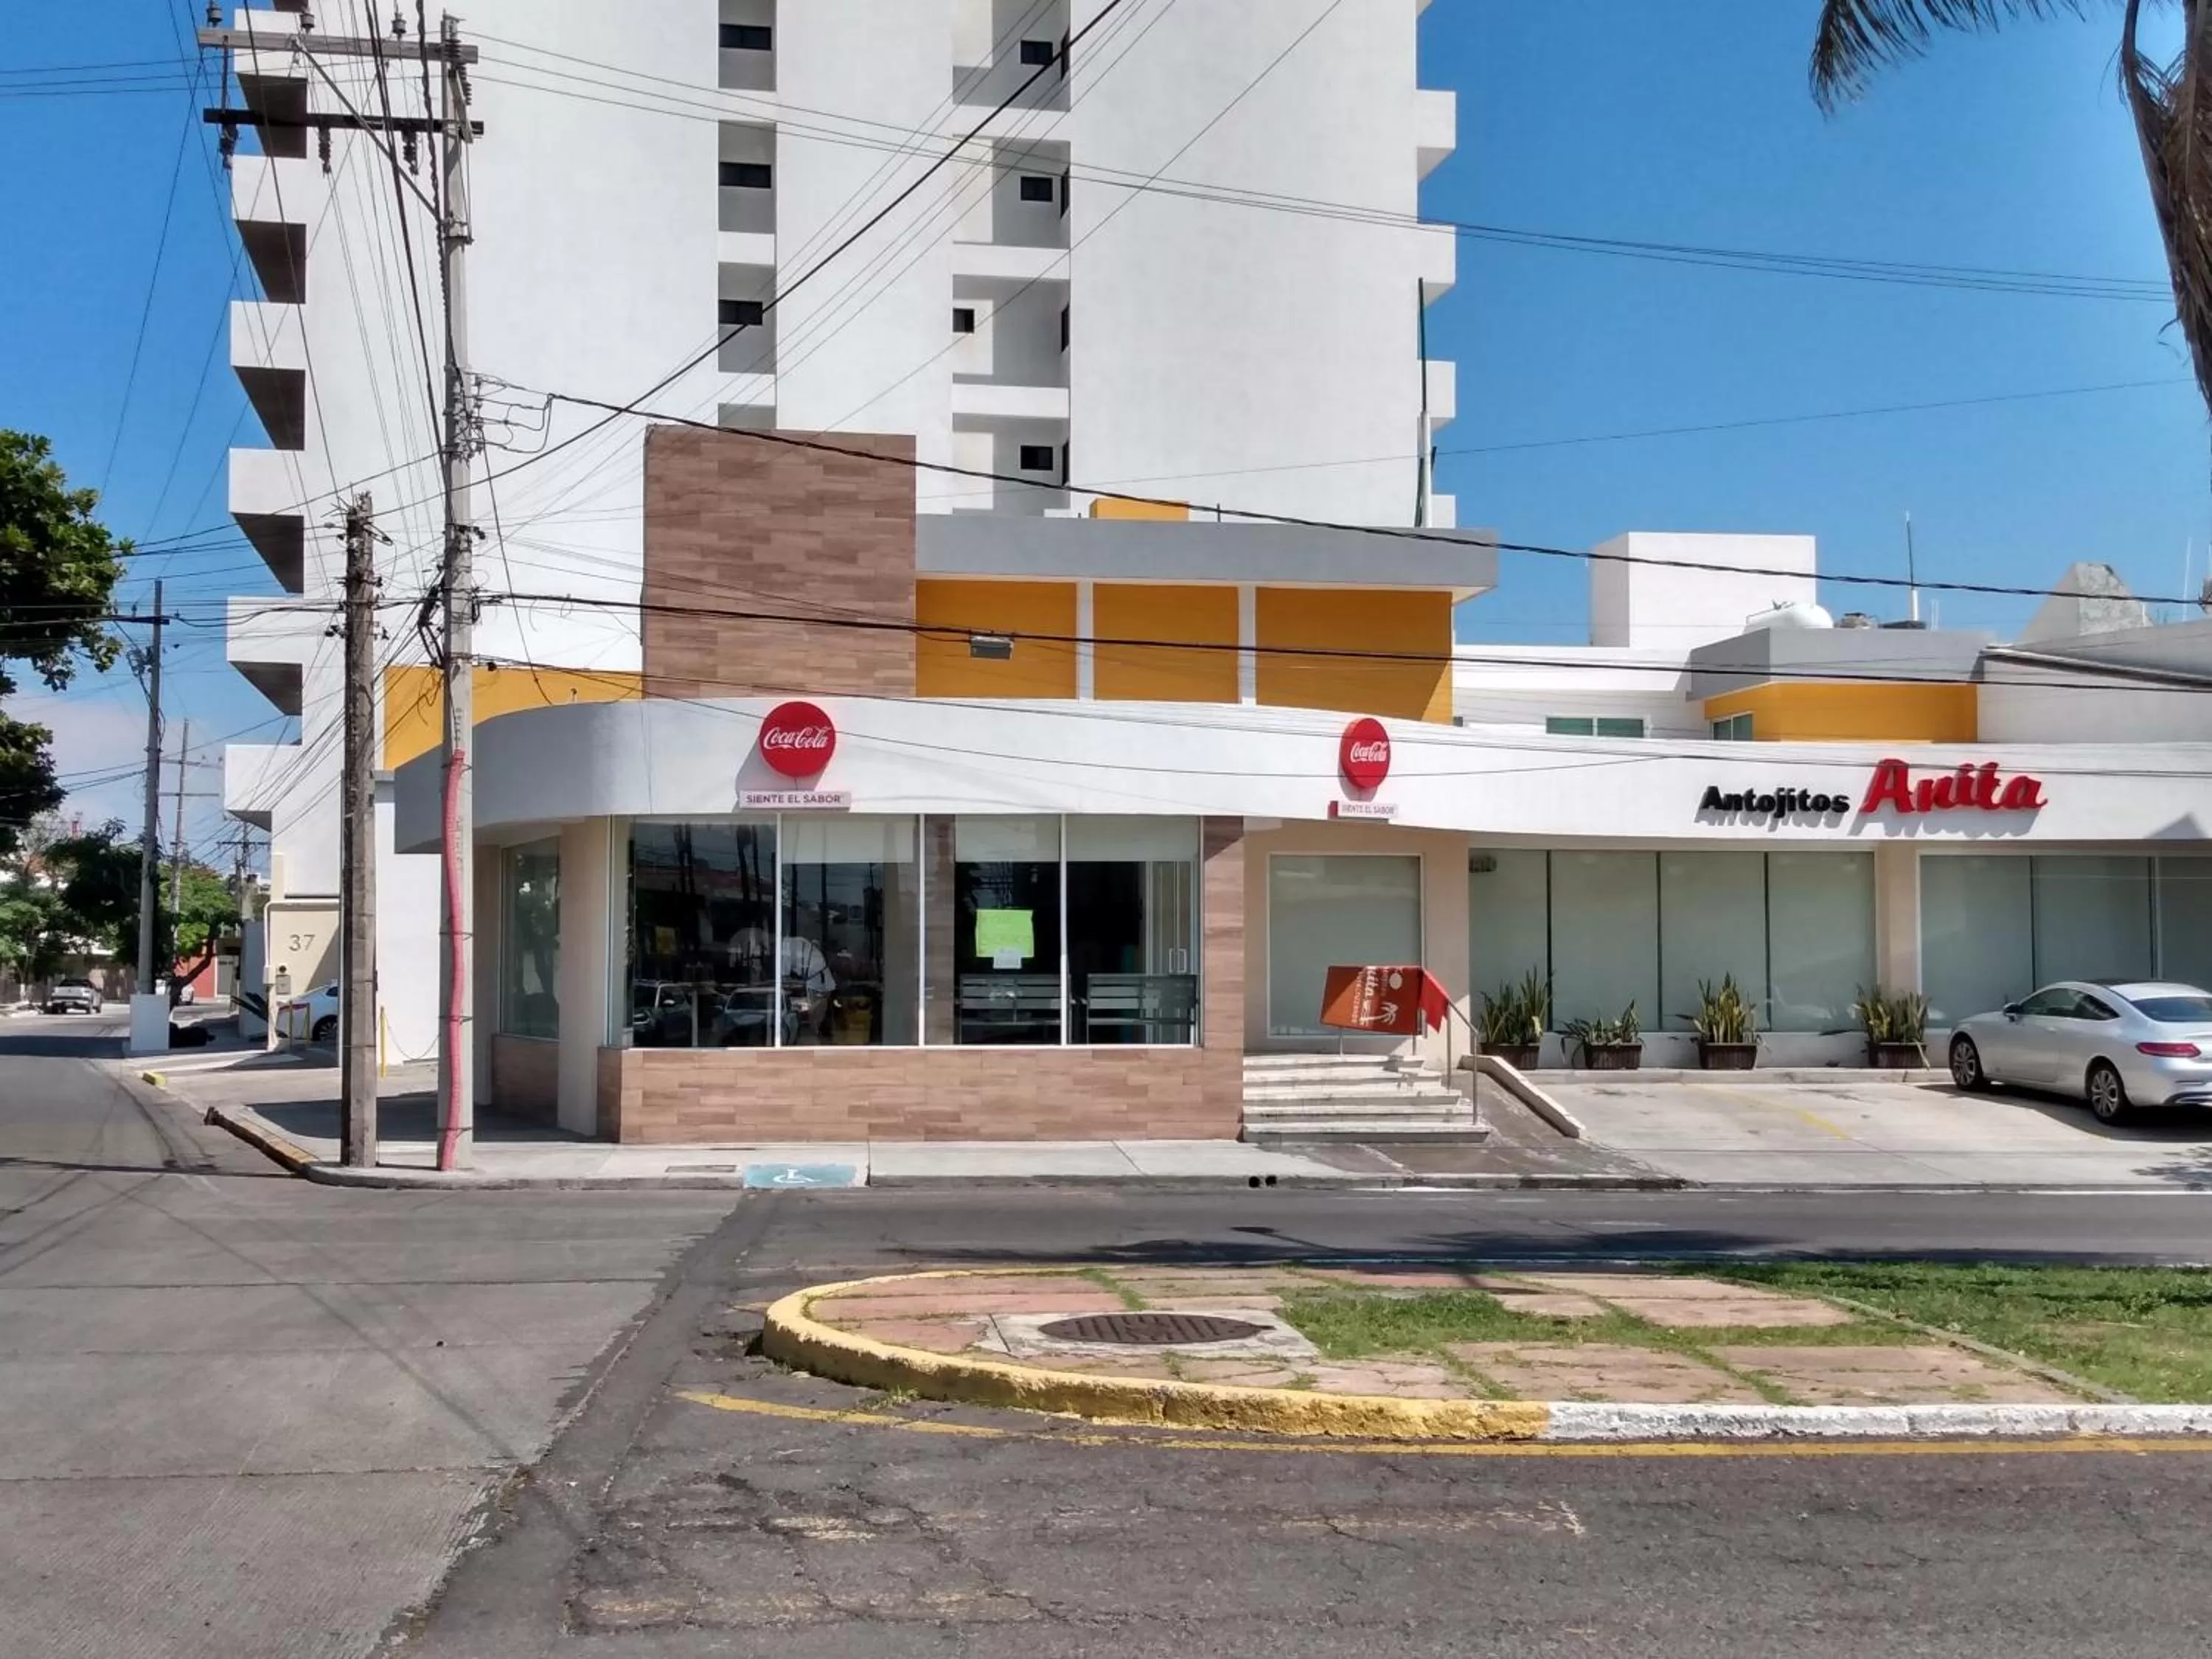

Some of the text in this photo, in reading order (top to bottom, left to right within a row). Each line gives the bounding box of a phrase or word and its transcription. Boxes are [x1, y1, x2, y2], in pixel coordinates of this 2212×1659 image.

[763, 725, 832, 750] Coca-Cola
[1350, 741, 1388, 763] Coca-Cola
[745, 794, 841, 804] SIENTE EL SABOR
[1700, 758, 2048, 818] Antojitos Anita
[288, 933, 316, 952] 37
